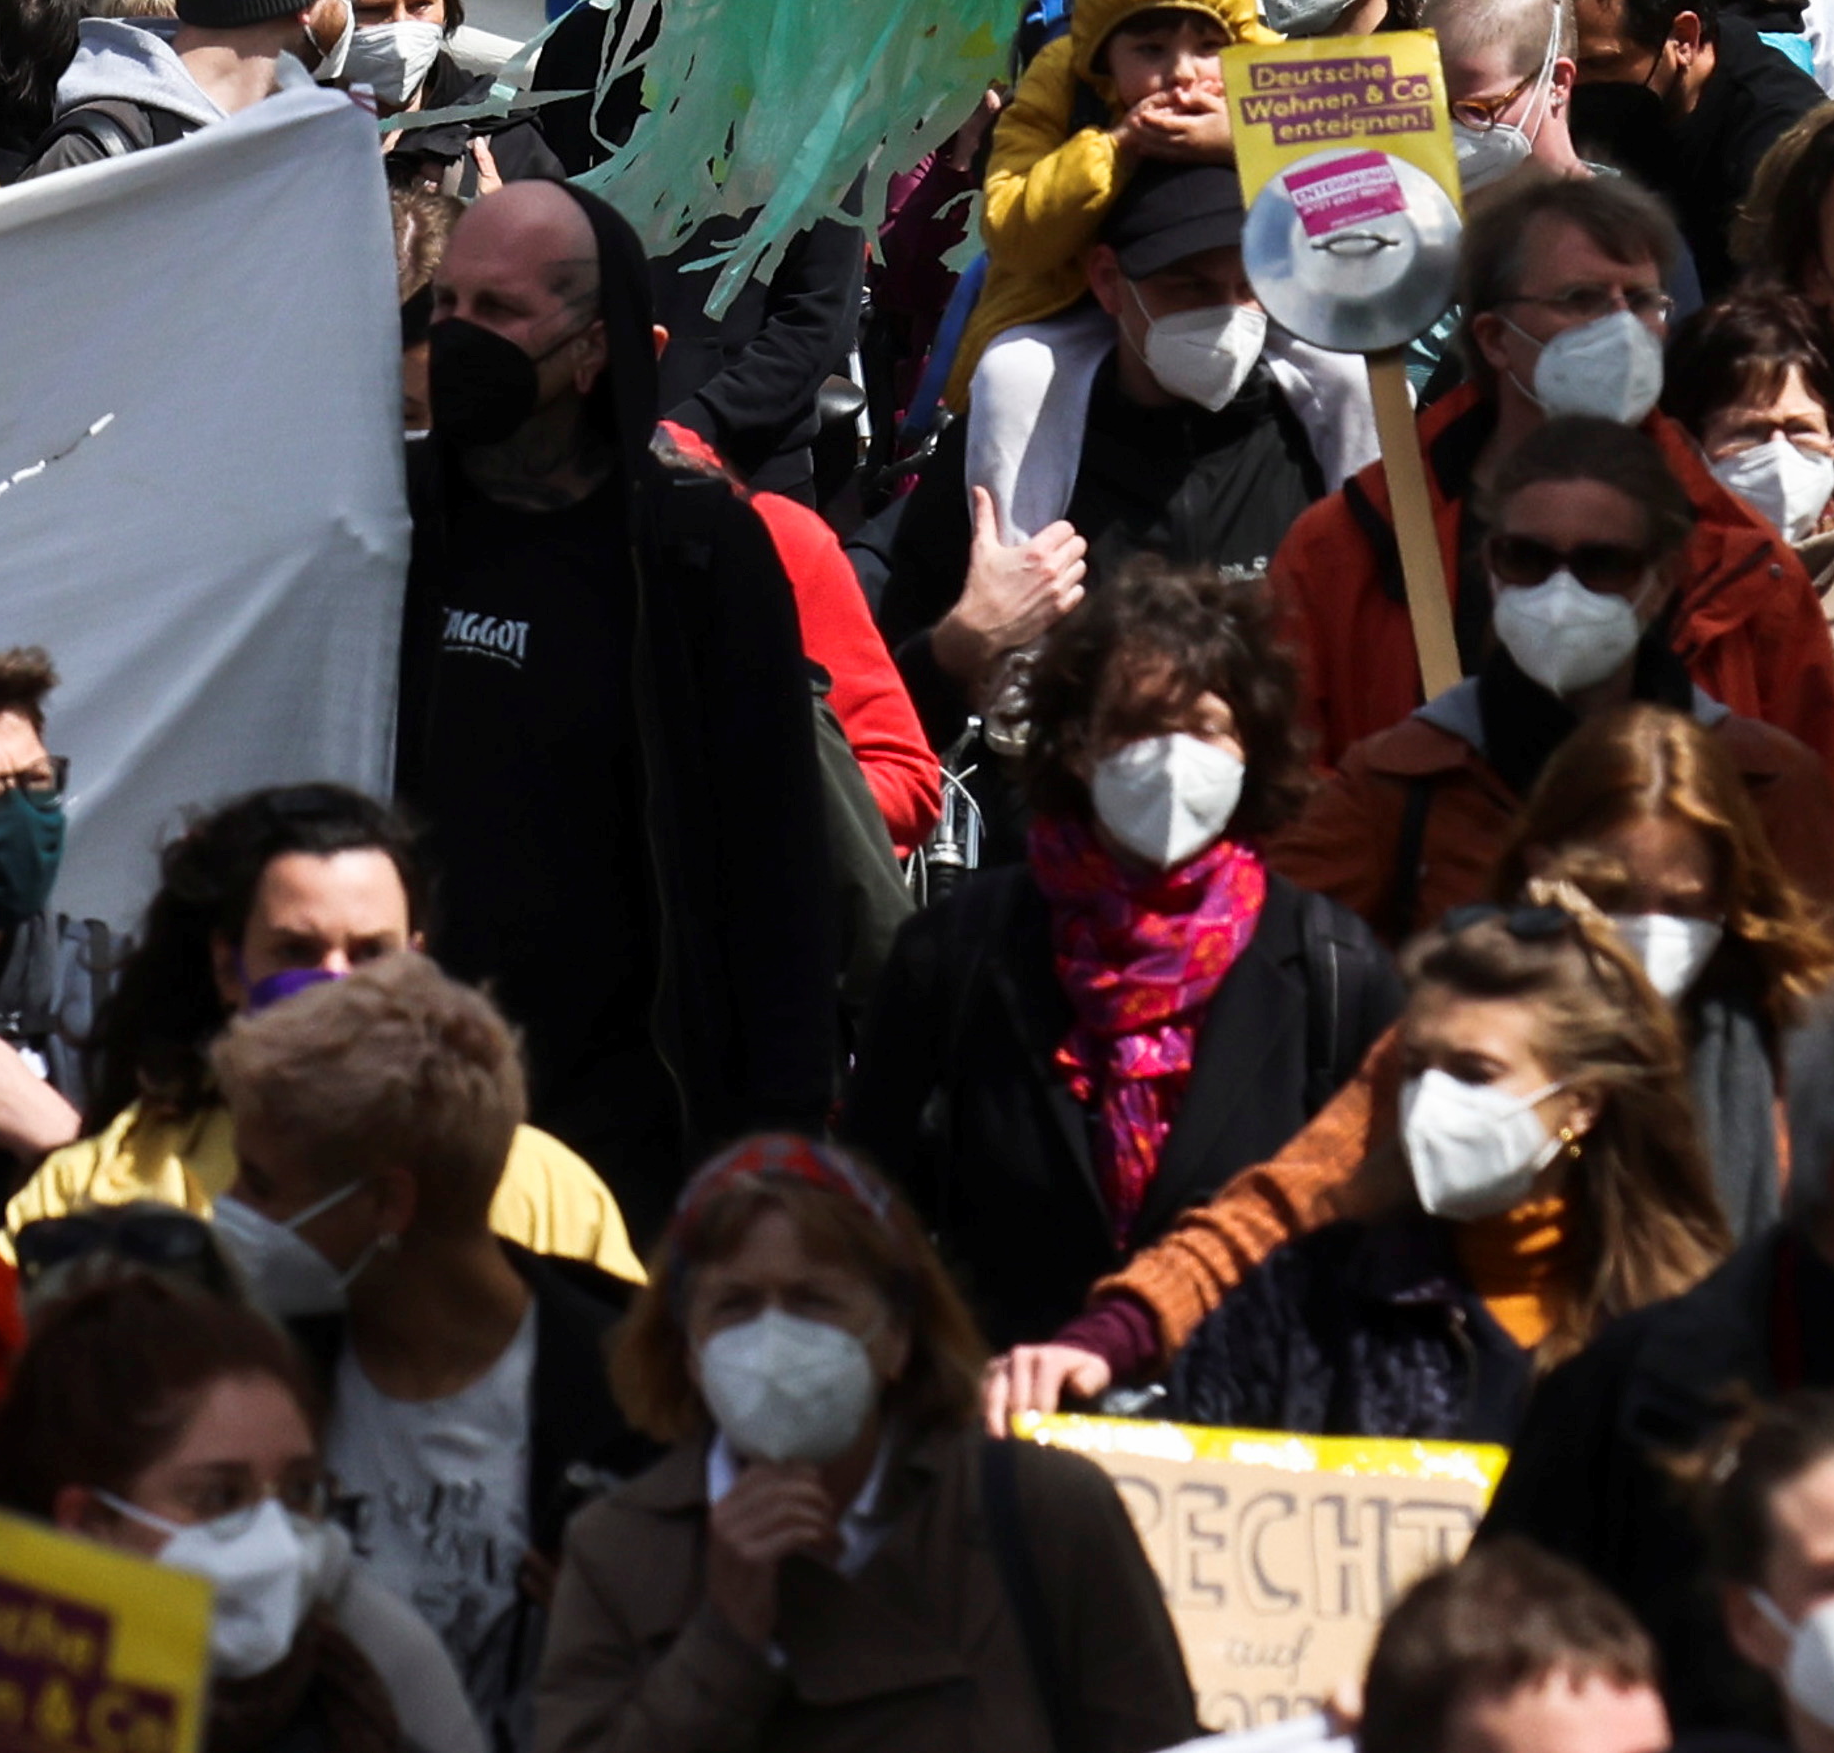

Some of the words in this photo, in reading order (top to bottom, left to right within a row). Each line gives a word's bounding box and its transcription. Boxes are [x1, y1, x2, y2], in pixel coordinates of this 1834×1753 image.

[1255, 62, 1387, 90] Deutsche
[1245, 91, 1358, 121] Wohnen
[1366, 85, 1384, 105] &
[1391, 77, 1431, 101] Co
[1279, 108, 1431, 140] enteignen!
